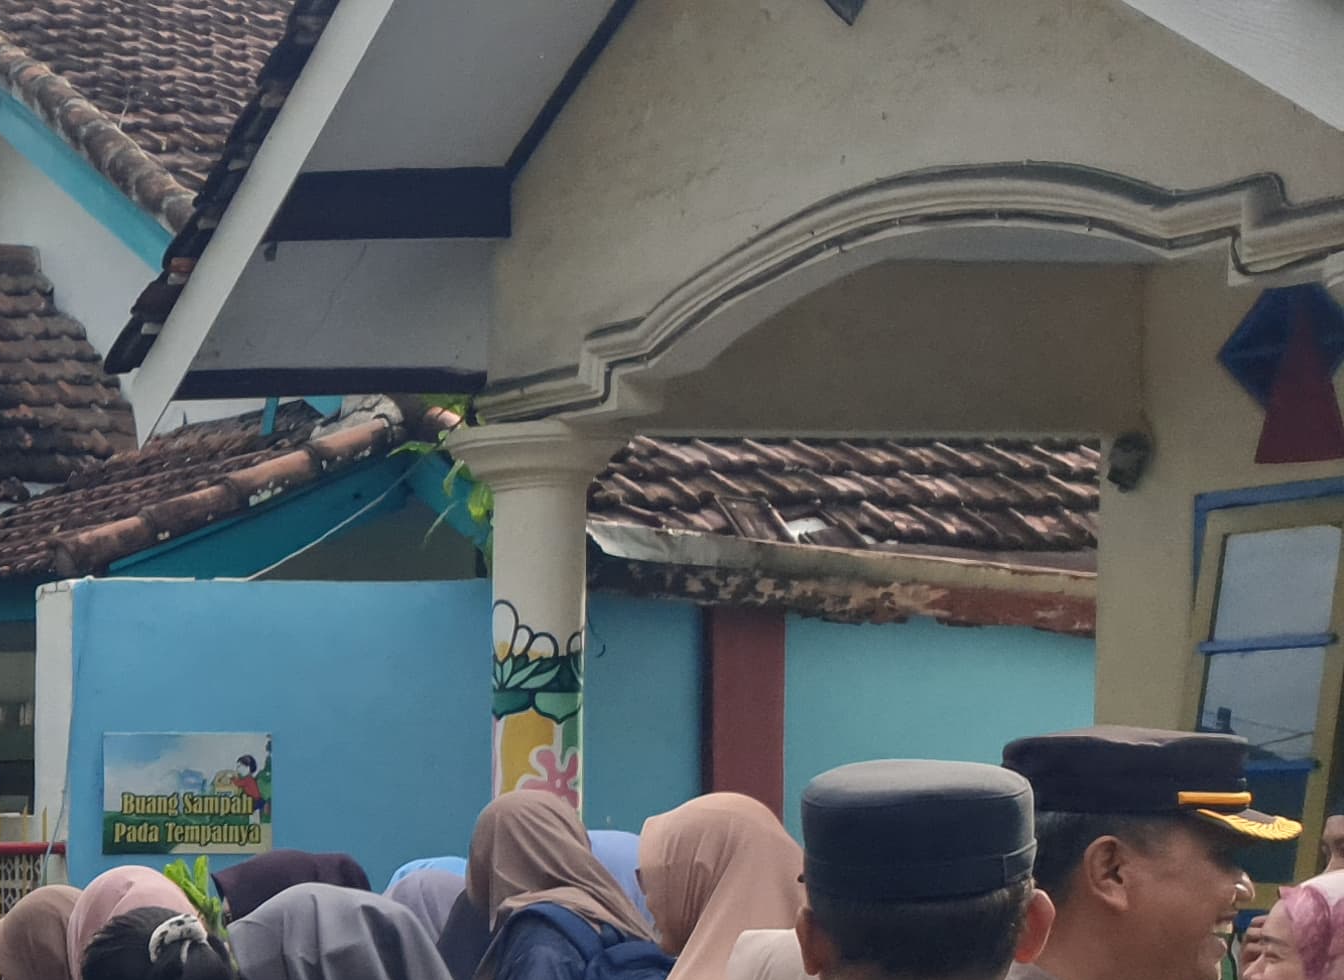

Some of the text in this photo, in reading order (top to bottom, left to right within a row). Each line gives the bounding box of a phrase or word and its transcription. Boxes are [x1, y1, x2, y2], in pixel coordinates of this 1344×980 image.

[122, 793, 253, 815] Buang Sampah
[115, 824, 260, 845] Pada Tempatnya
